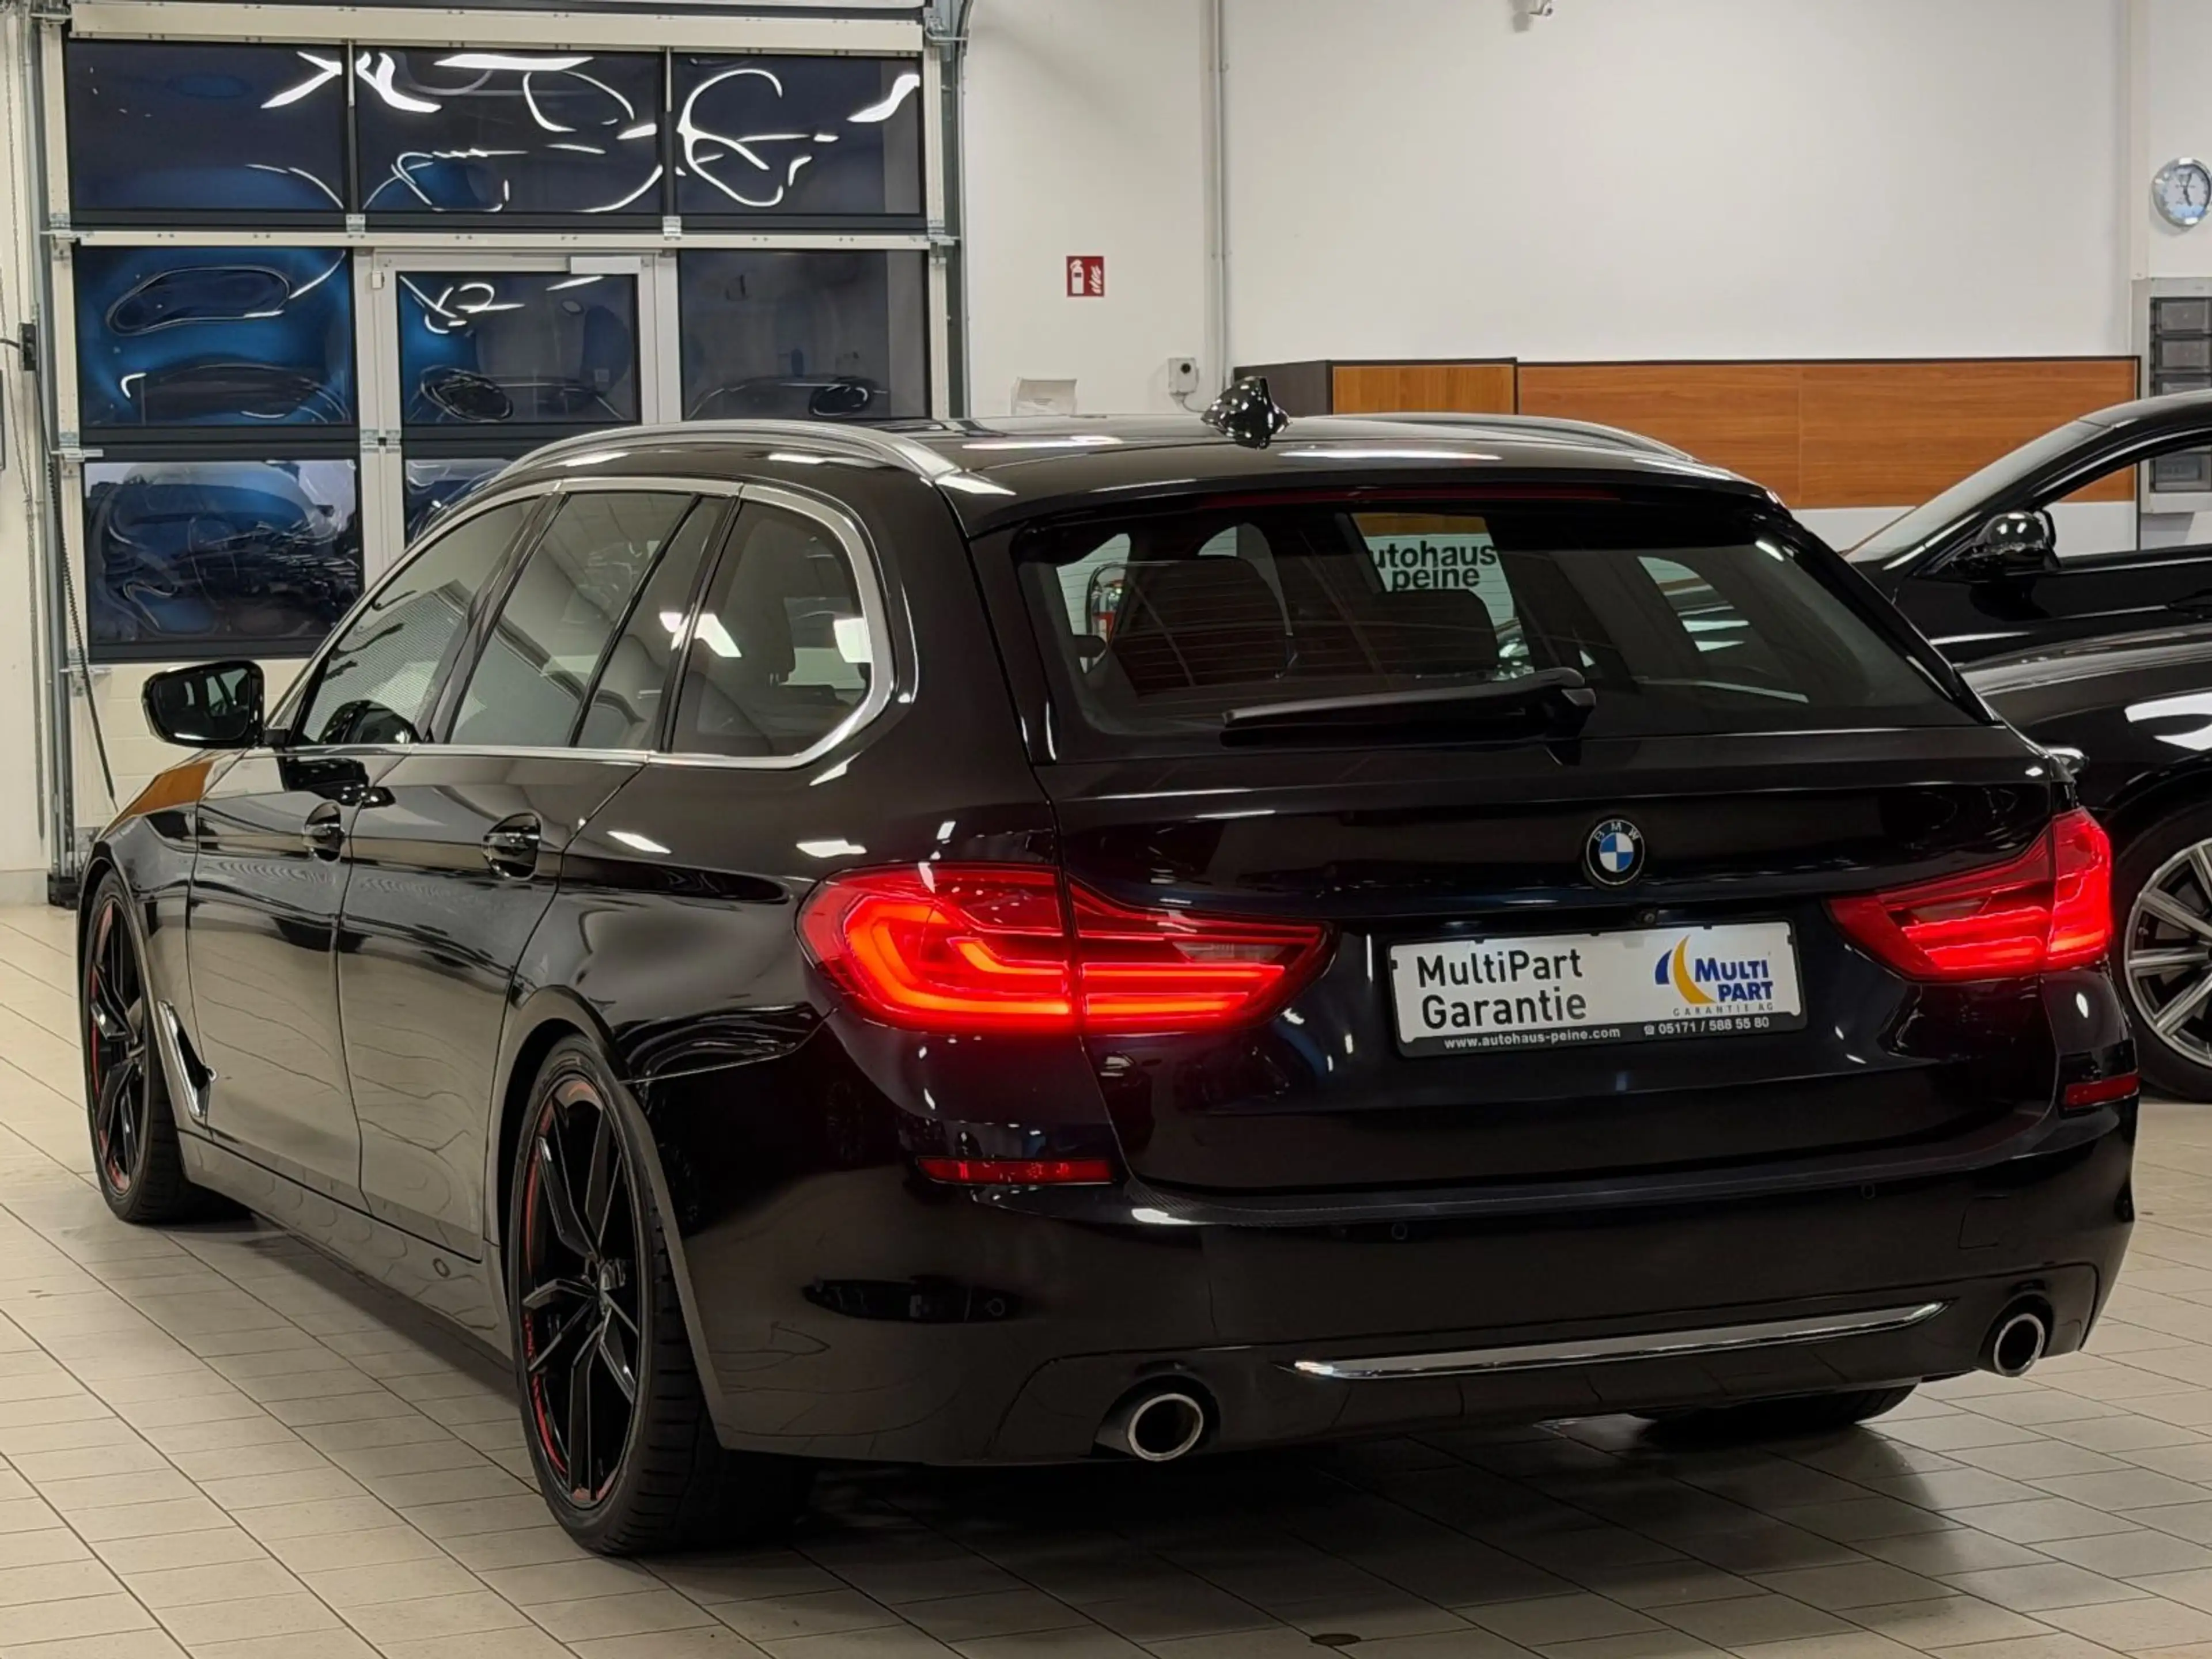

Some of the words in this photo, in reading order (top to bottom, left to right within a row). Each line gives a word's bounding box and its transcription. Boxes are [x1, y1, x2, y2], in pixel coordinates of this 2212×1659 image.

[1369, 540, 1497, 569] utohaus
[1392, 567, 1480, 592] peine
[1594, 822, 1639, 841] BMW
[1417, 949, 1582, 987] MultiPart
[1718, 981, 1773, 1002] PART
[1422, 986, 1586, 1029] Garantie
[1444, 1028, 1620, 1049] www.autohaus-peine.com
[1658, 1021, 1696, 1035] 05171
